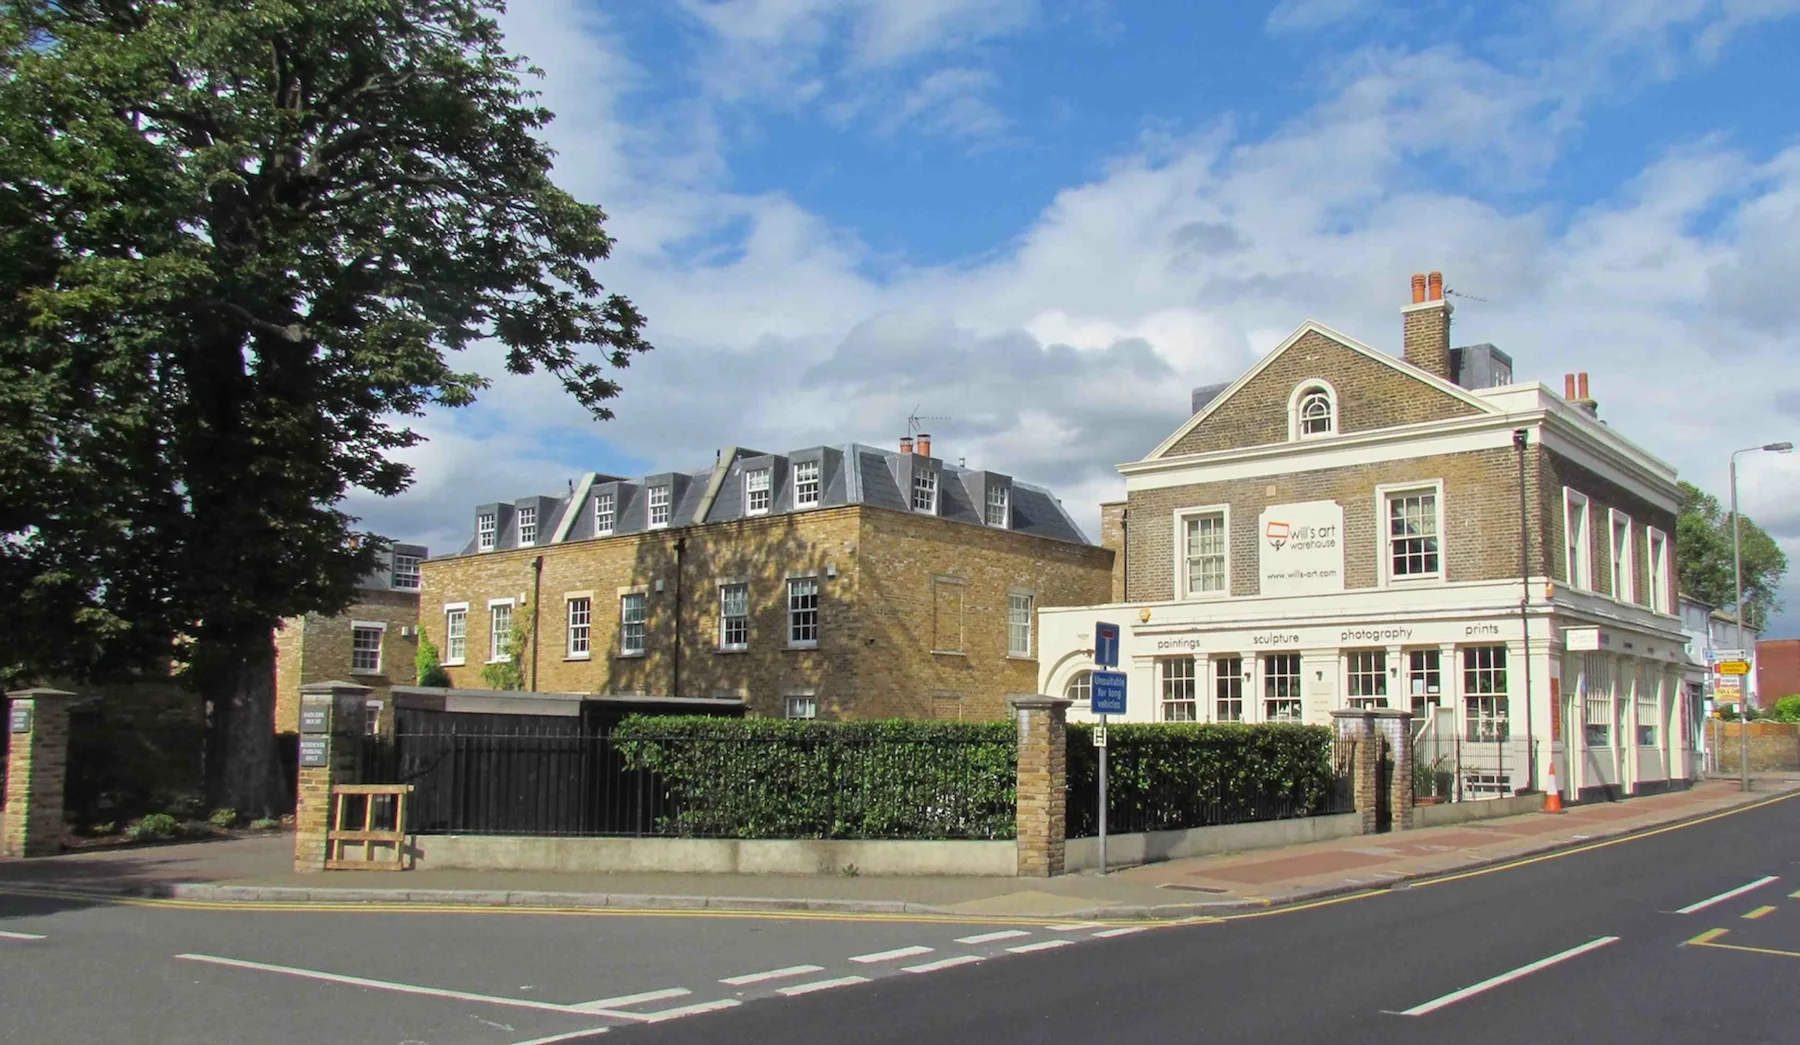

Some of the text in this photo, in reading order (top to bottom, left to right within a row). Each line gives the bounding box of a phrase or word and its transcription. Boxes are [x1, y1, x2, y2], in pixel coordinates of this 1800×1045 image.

[1290, 524, 1336, 540] will's art
[1290, 539, 1336, 550] warehouse
[1267, 570, 1337, 580] www.wills-art.com
[1341, 626, 1413, 641] photography
[1465, 623, 1499, 636] prints
[1157, 637, 1201, 650] paintings
[1253, 632, 1300, 646] sculpture
[1094, 675, 1125, 688] Unsuitable
[1097, 687, 1122, 700] for long
[1097, 699, 1121, 710] vehicles
